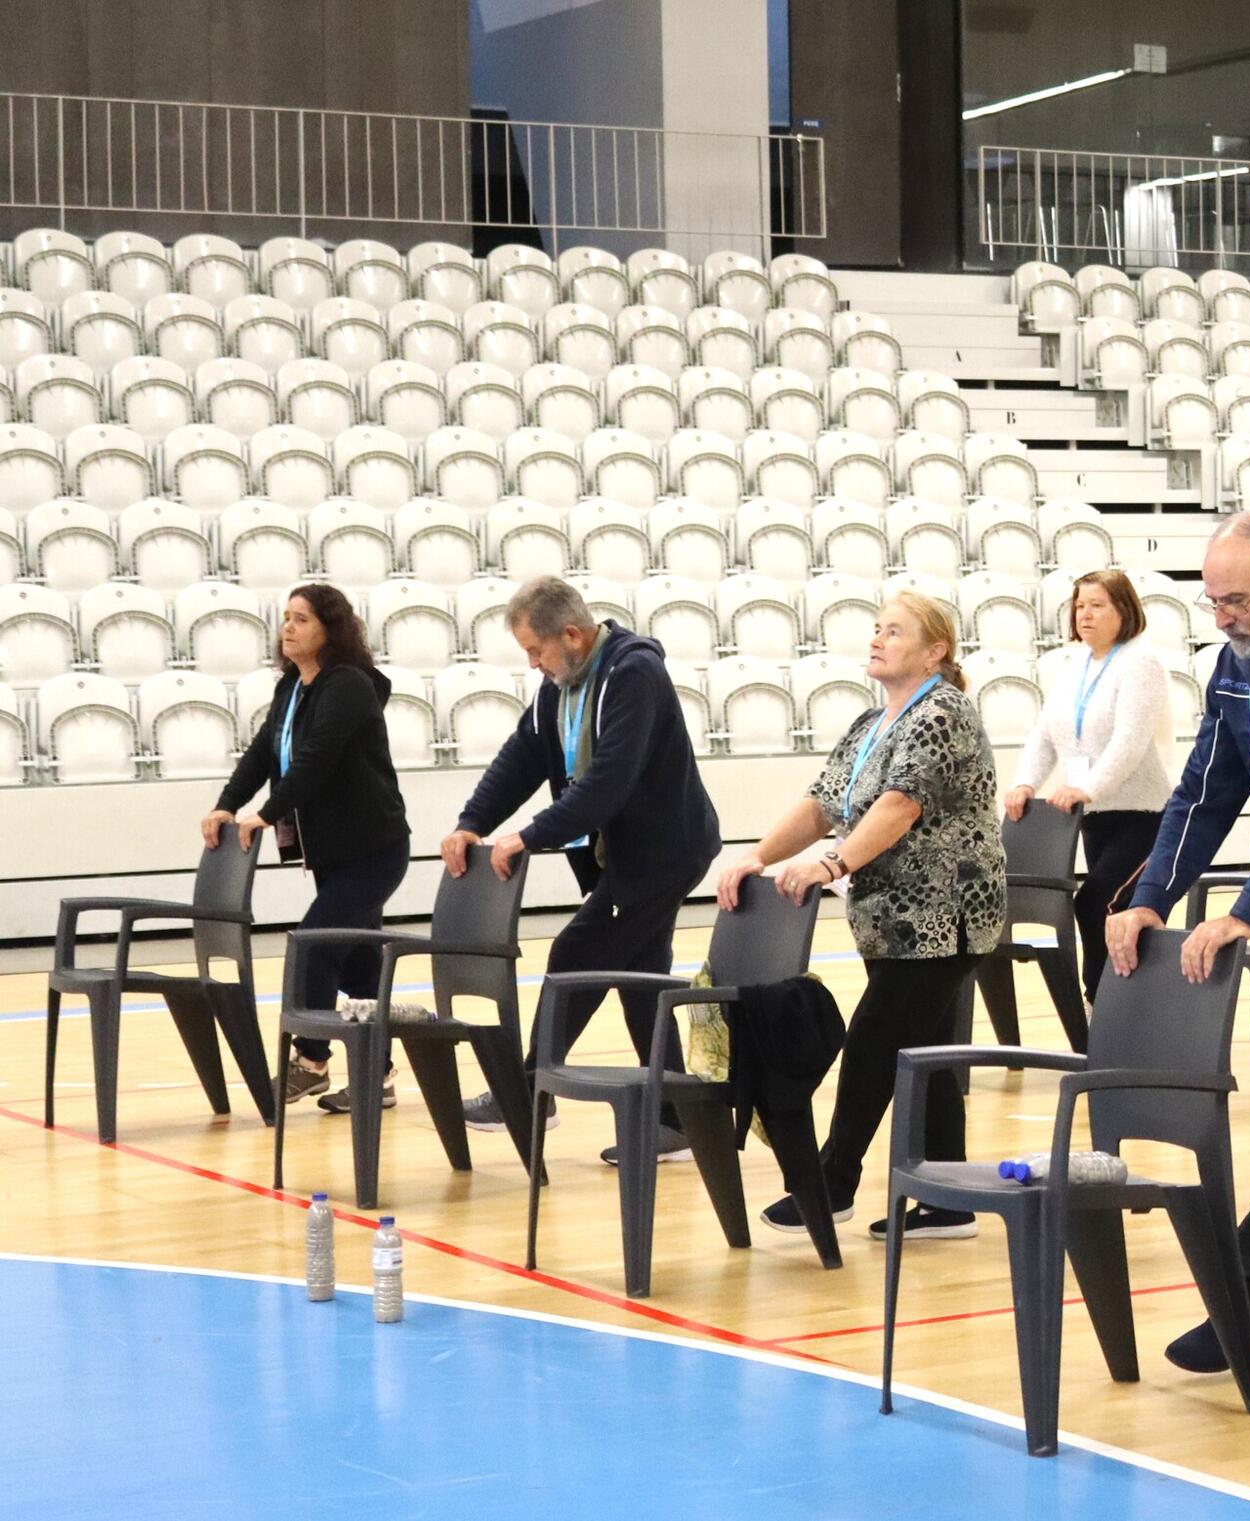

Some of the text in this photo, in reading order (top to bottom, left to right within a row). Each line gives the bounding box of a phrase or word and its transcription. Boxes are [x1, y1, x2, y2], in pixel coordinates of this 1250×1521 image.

[1006, 411, 1017, 425] B
[1076, 473, 1087, 487] C
[1147, 538, 1158, 552] D
